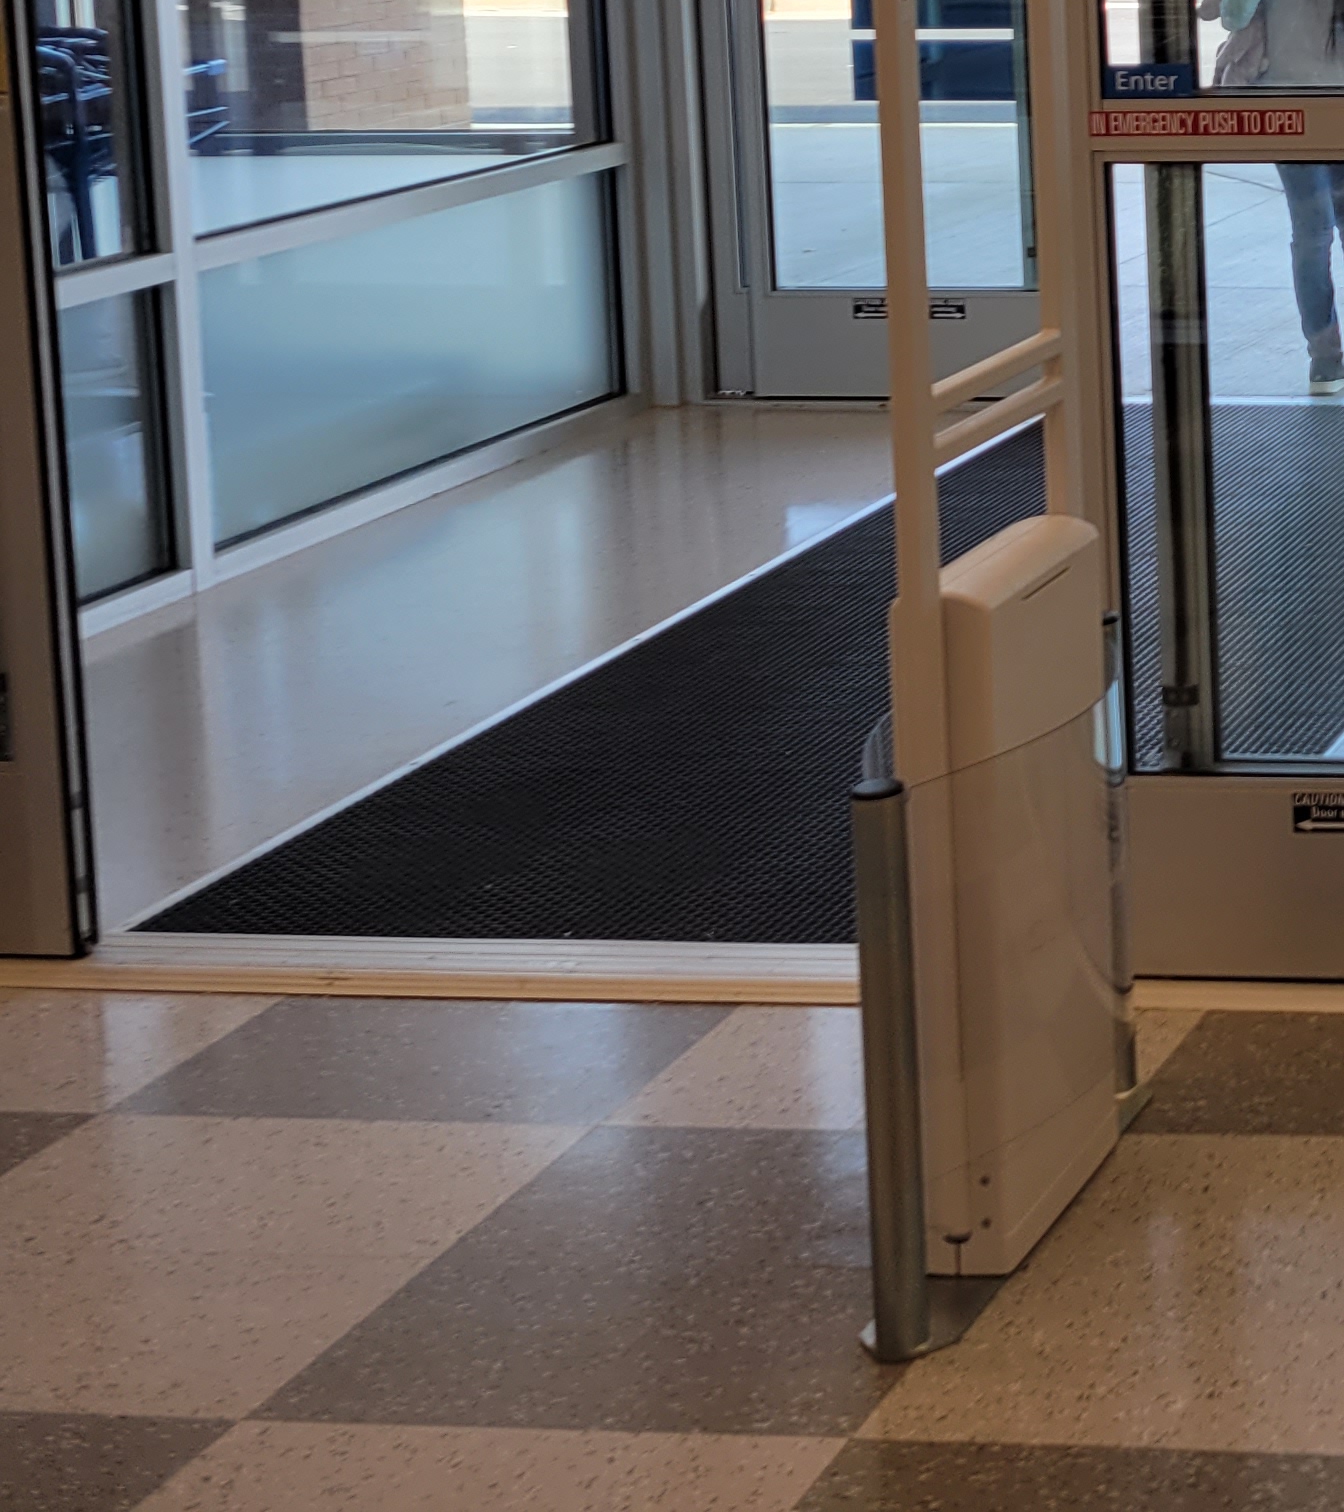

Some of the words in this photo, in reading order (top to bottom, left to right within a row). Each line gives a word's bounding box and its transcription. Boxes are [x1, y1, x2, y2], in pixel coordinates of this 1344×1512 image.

[1115, 70, 1179, 91] Enter
[1091, 114, 1107, 134] IN
[1109, 113, 1195, 134] EMERGENCY
[1200, 112, 1238, 133] PUSH
[1241, 111, 1262, 133] TO
[1265, 111, 1304, 133] OPEN
